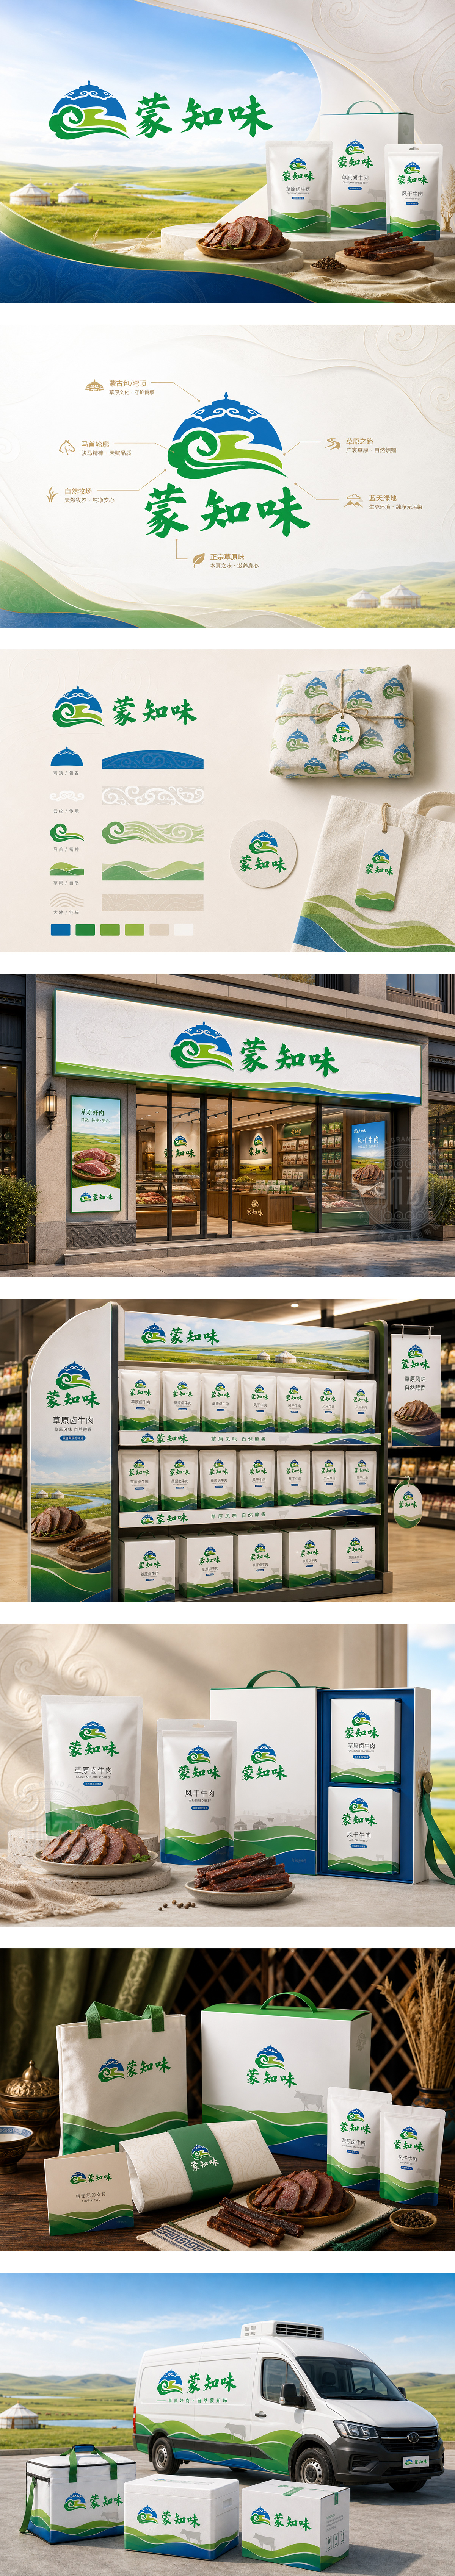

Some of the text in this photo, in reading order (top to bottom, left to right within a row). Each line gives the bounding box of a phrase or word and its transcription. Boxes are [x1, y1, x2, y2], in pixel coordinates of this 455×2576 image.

[135, 92, 273, 138] 蒙知味
[338, 155, 373, 168] 蒙知味
[282, 169, 314, 181] 蒙知味
[398, 174, 428, 185] 蒙知味
[144, 483, 311, 538] 蒙知味
[112, 696, 197, 726] 蒙知味
[332, 734, 354, 743] 蒙知味
[240, 855, 287, 873] 蒙知味
[366, 864, 394, 876] 蒙知味
[240, 1037, 339, 1077] 蒙知味
[357, 1136, 379, 1144] 风干牛肉
[249, 1147, 268, 1157] 蒙知味
[246, 1207, 264, 1216] 蒙知味
[170, 1327, 220, 1345] 蒙知味
[401, 1358, 430, 1369] 蒙知味
[46, 1389, 100, 1408] 蒙知味
[157, 1433, 188, 1443] 蒙知味
[157, 1513, 188, 1525] 蒙知味
[199, 1556, 220, 1565] 蒙知味
[250, 1552, 270, 1561] 蒙知味
[138, 1560, 161, 1569] 蒙知味
[345, 1727, 379, 1739] 蒙知味
[69, 1740, 119, 1757] 蒙知味
[178, 1765, 221, 1780] 蒙知味
[242, 1765, 287, 1781] 蒙知味
[342, 1813, 377, 1826] 蒙知味
[127, 2057, 171, 2077] 蒙知味
[247, 2068, 297, 2088] 蒙知味
[340, 2121, 371, 2134] 蒙知味
[394, 2139, 424, 2152] 蒙知味
[190, 2157, 220, 2171] 蒙知味
[88, 2173, 112, 2182] 蒙知味
[187, 2372, 237, 2394] 蒙知味
[90, 2493, 123, 2509] 蒙知味
[162, 2510, 200, 2528] 蒙知味
[274, 2513, 312, 2531] 蒙知味
